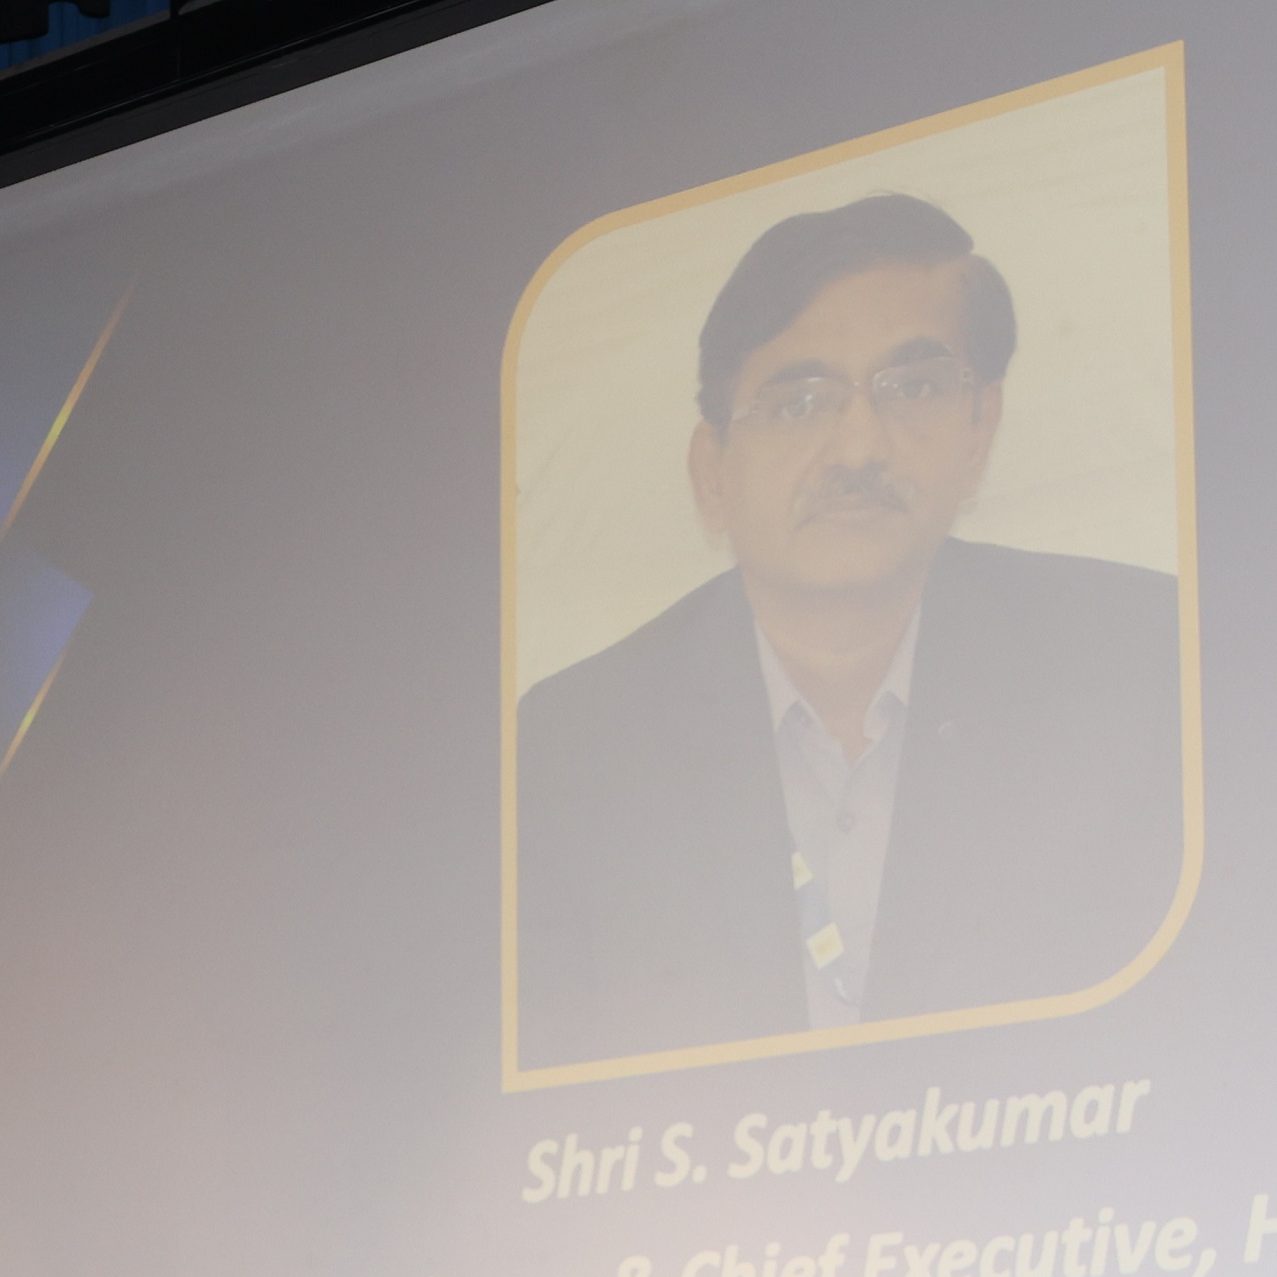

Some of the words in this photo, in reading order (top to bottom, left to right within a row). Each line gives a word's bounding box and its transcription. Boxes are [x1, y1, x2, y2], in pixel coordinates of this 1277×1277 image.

[522, 1129, 641, 1203] Shri
[654, 1124, 708, 1189] S.
[728, 1078, 1150, 1184] Satyakumar
